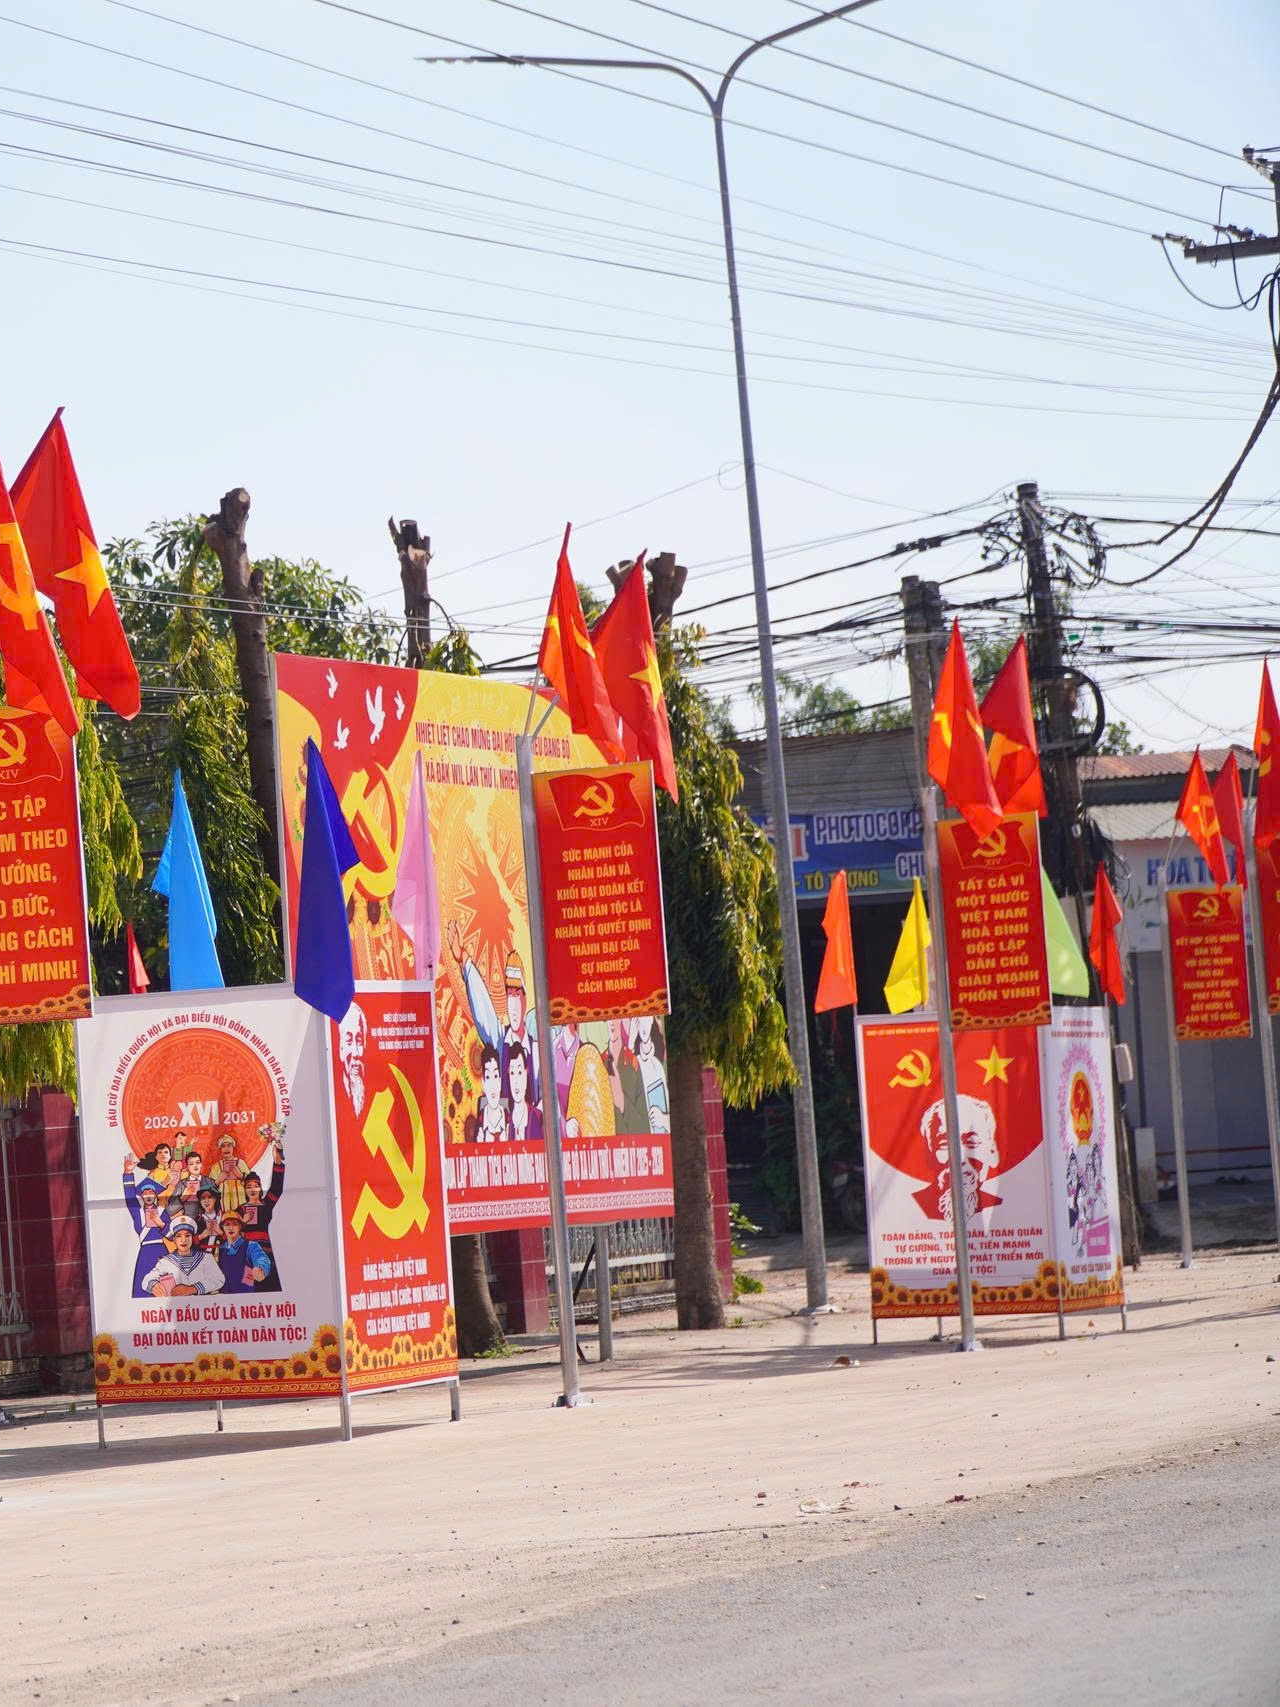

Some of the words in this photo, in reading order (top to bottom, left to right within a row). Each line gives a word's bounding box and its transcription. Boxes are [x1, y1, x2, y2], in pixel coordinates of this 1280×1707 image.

[13, 795, 46, 823] TẬP
[22, 828, 68, 849] THEO
[562, 848, 581, 863] SỨC
[584, 846, 611, 862] MẠNH
[614, 841, 633, 857] CỦA
[568, 866, 594, 881] NHÂN
[597, 864, 616, 879] DÂN
[619, 860, 630, 875] VÀ
[13, 894, 55, 918] ĐỨC,
[562, 905, 585, 919] TOÀN
[589, 902, 608, 916] DÂN
[610, 901, 628, 916] TỘC
[630, 898, 642, 912] LÀ
[24, 925, 73, 948] CÁCH
[22, 959, 77, 983] MINH!
[577, 978, 602, 994] CÁCH
[605, 977, 636, 992] MẠNG!
[145, 1114, 177, 1130] 2026
[178, 1100, 219, 1127] XVI
[224, 1111, 256, 1125] 2031
[141, 1306, 172, 1323] NGÀY
[176, 1303, 199, 1322] BẦU
[204, 1302, 220, 1321] CỬ
[223, 1303, 237, 1320] LÀ
[241, 1303, 273, 1319] NGÀY
[276, 1301, 296, 1321] HỘI
[134, 1332, 152, 1349] ĐẠI
[157, 1330, 188, 1346] ĐOÀN
[192, 1325, 213, 1345] KẾT
[217, 1328, 248, 1344] TOÀN
[252, 1325, 273, 1342] DÂN
[280, 1326, 307, 1346] TỘC!
